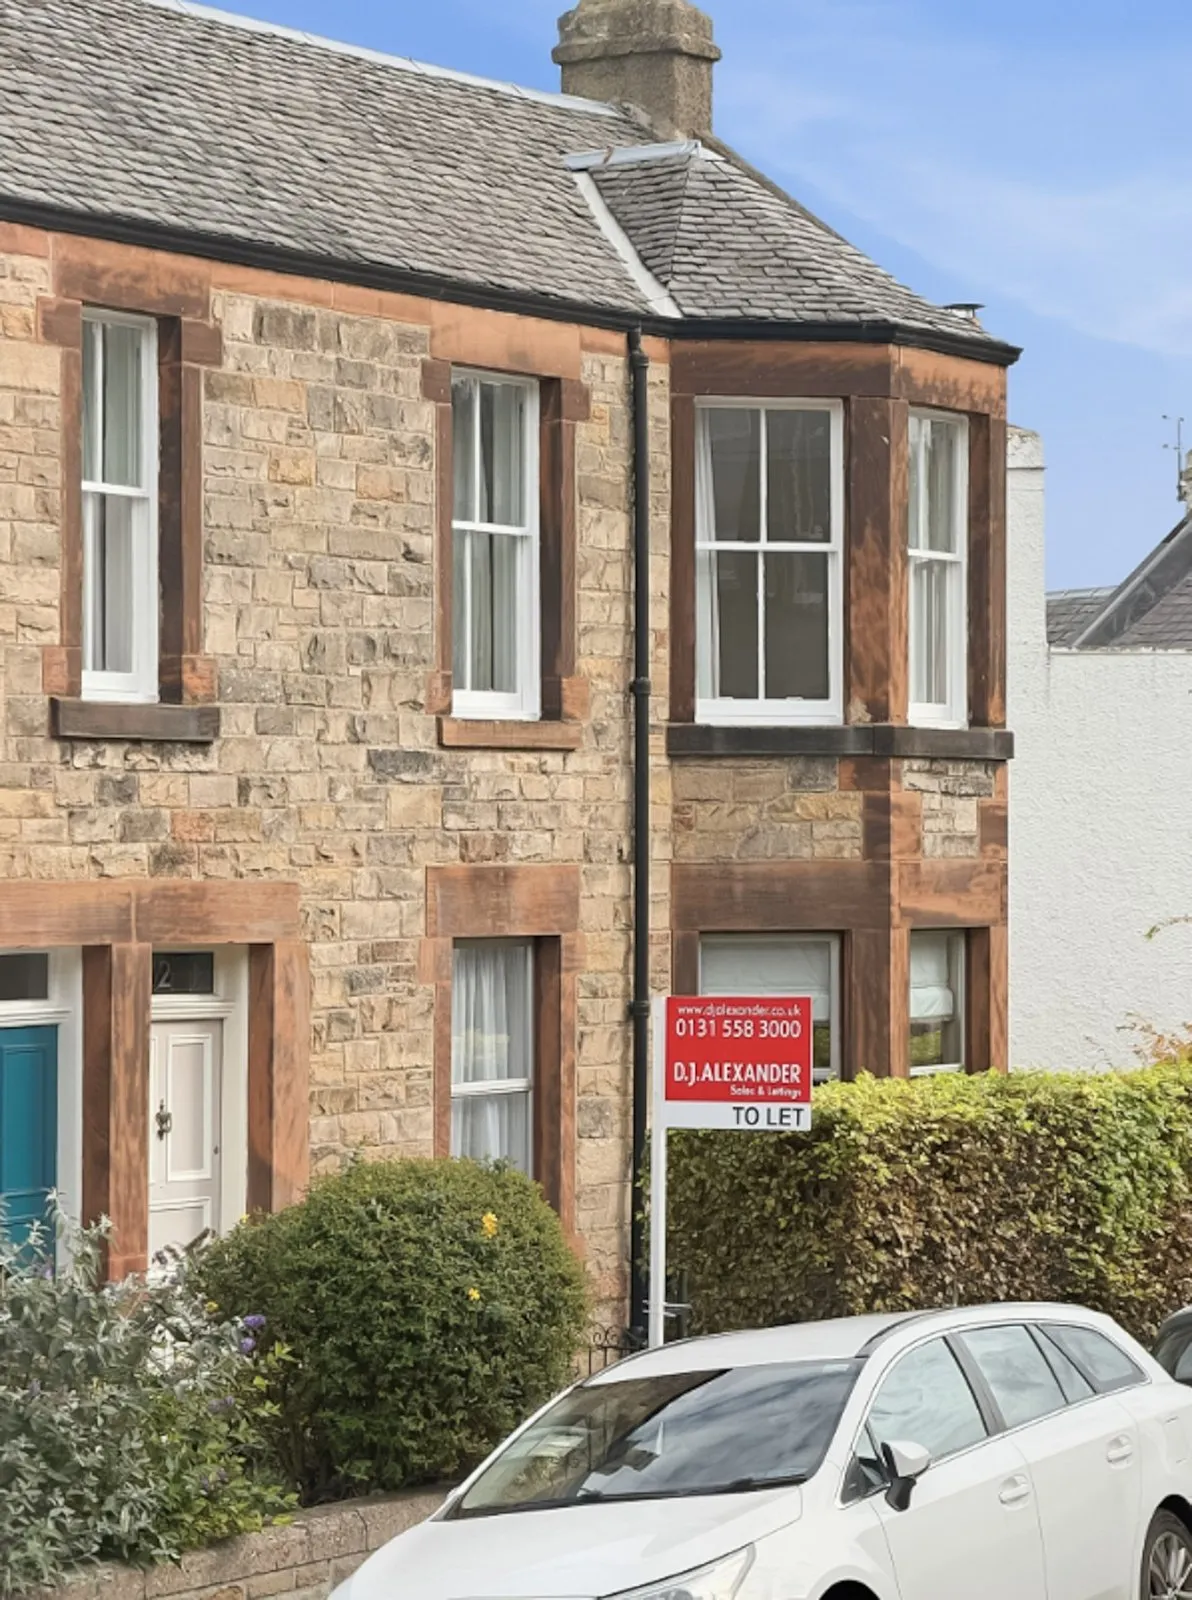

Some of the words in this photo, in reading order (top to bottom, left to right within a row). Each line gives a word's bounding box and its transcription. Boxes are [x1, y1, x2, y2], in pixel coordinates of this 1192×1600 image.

[157, 960, 172, 988] 2
[675, 1018, 716, 1037] 0131
[722, 1019, 754, 1038] 558
[758, 1020, 802, 1038] 3000
[729, 1085, 755, 1096] Sales
[757, 1086, 765, 1096] &
[767, 1086, 802, 1100] Lettings
[732, 1106, 759, 1126] TO
[766, 1107, 805, 1126] LET
